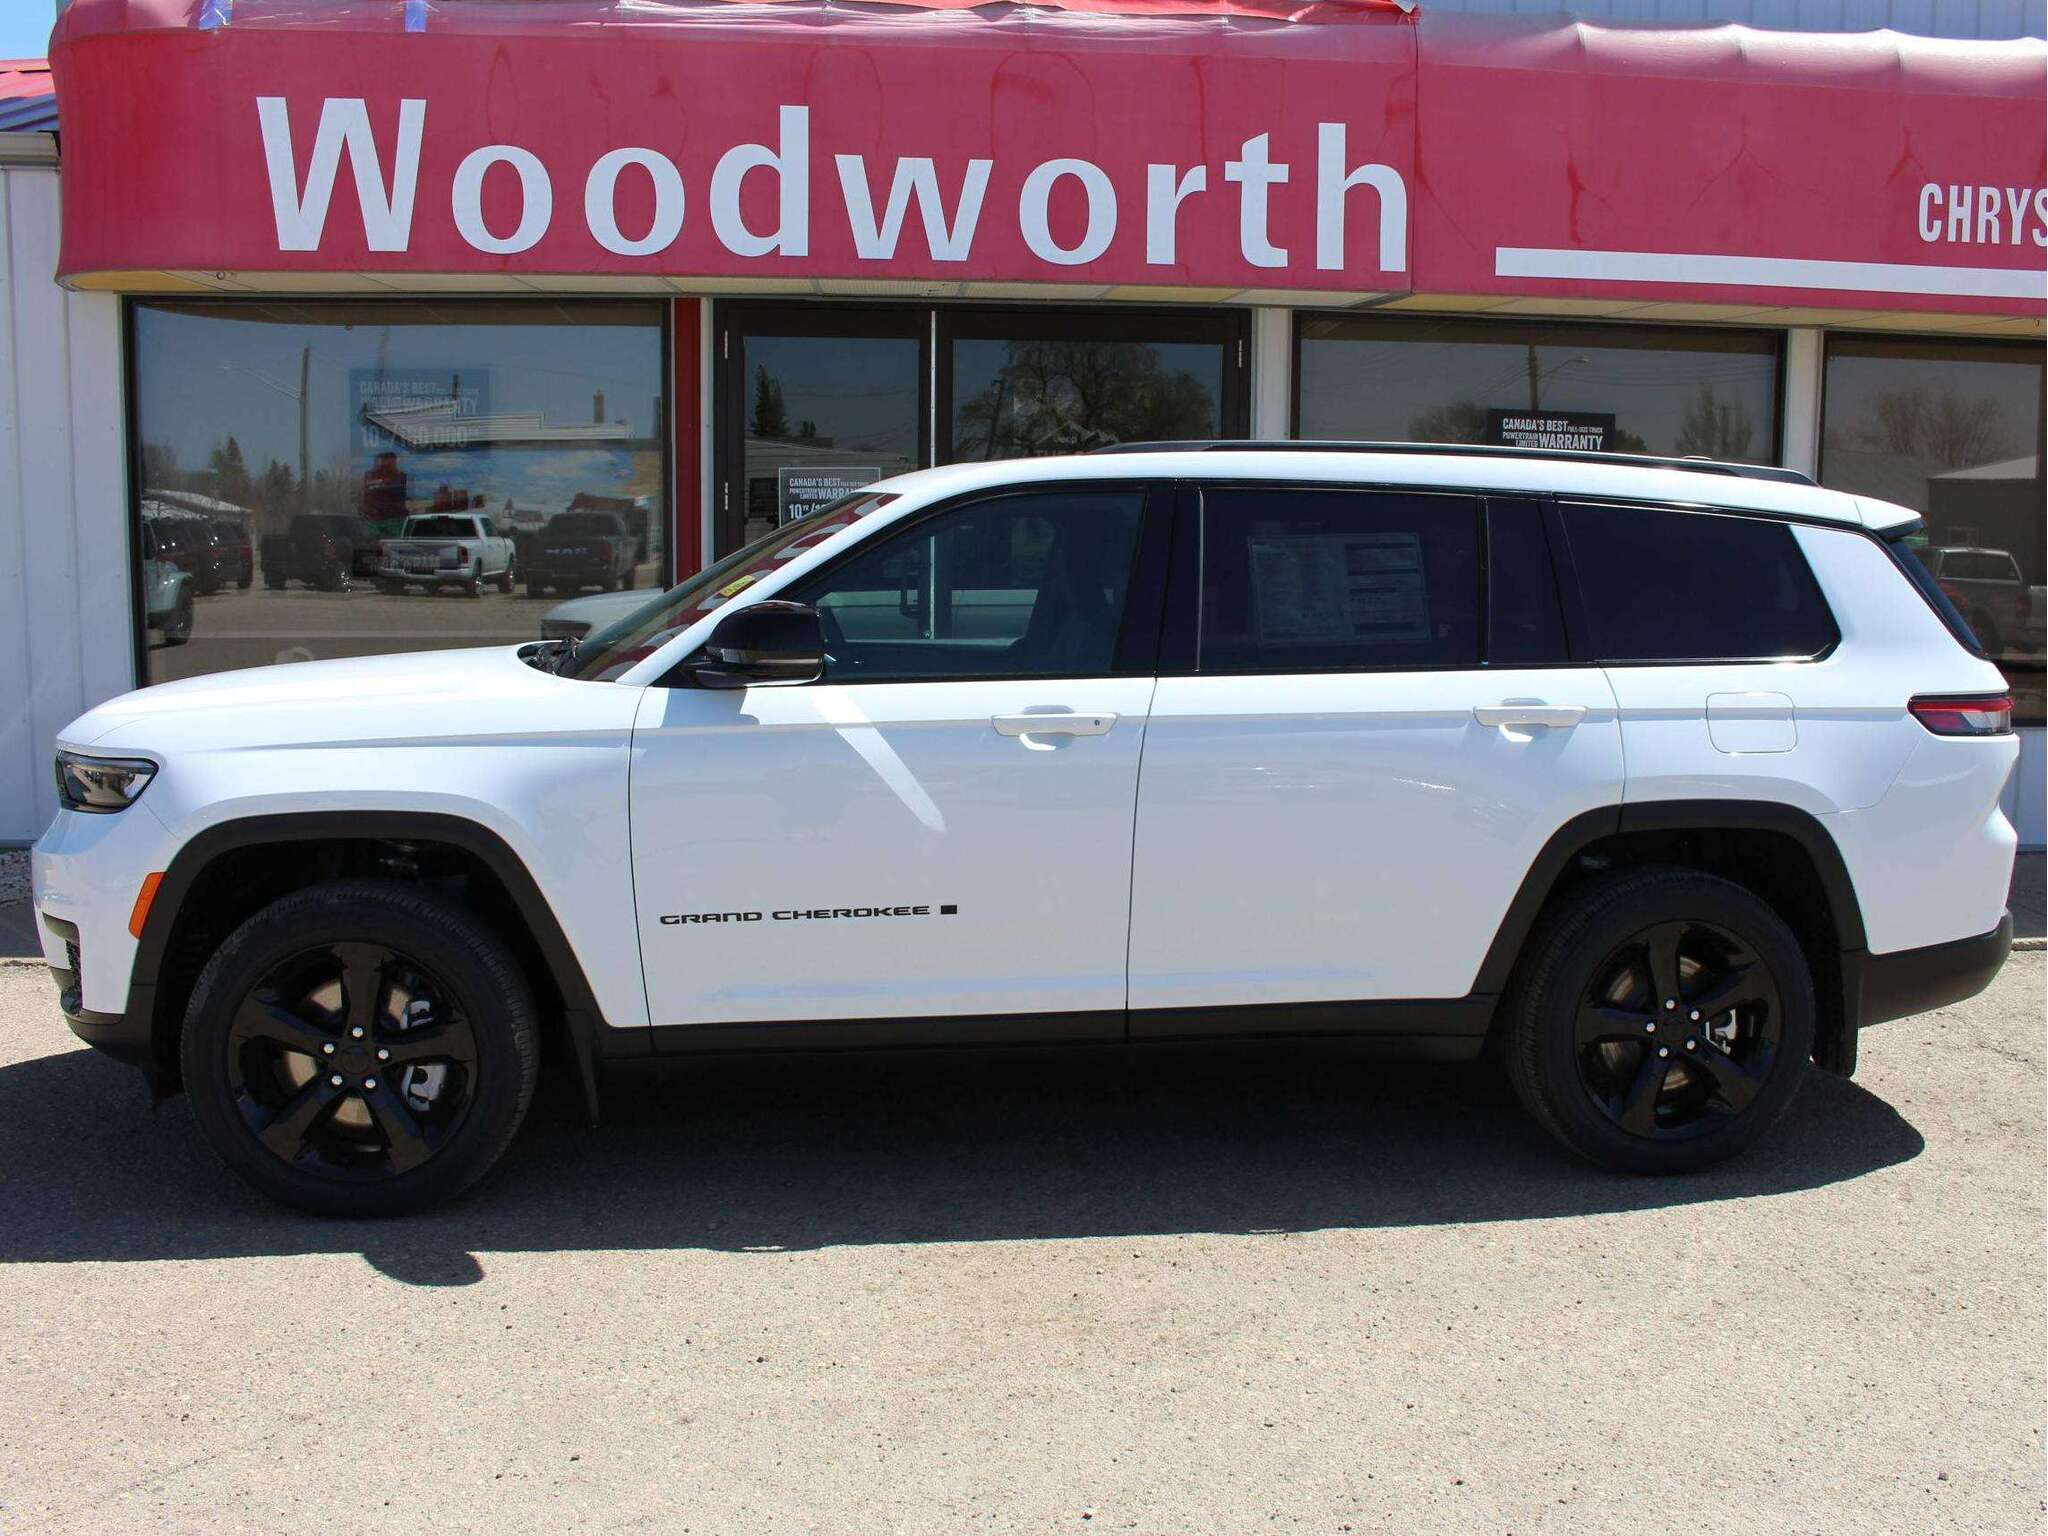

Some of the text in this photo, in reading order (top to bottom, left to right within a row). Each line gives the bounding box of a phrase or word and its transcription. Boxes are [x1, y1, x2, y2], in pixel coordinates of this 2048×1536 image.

[256, 96, 1408, 273] Woodworth
[1502, 417, 1545, 431] CANADA'S
[1546, 420, 1568, 432] BEST
[1502, 431, 1538, 440] POWERTRAIN
[1515, 433, 1604, 450] LIMITED WARRANTY
[789, 477, 822, 487] CANADA'S
[824, 477, 841, 487] BEST
[659, 905, 930, 925] GRAND CHEROKEE
